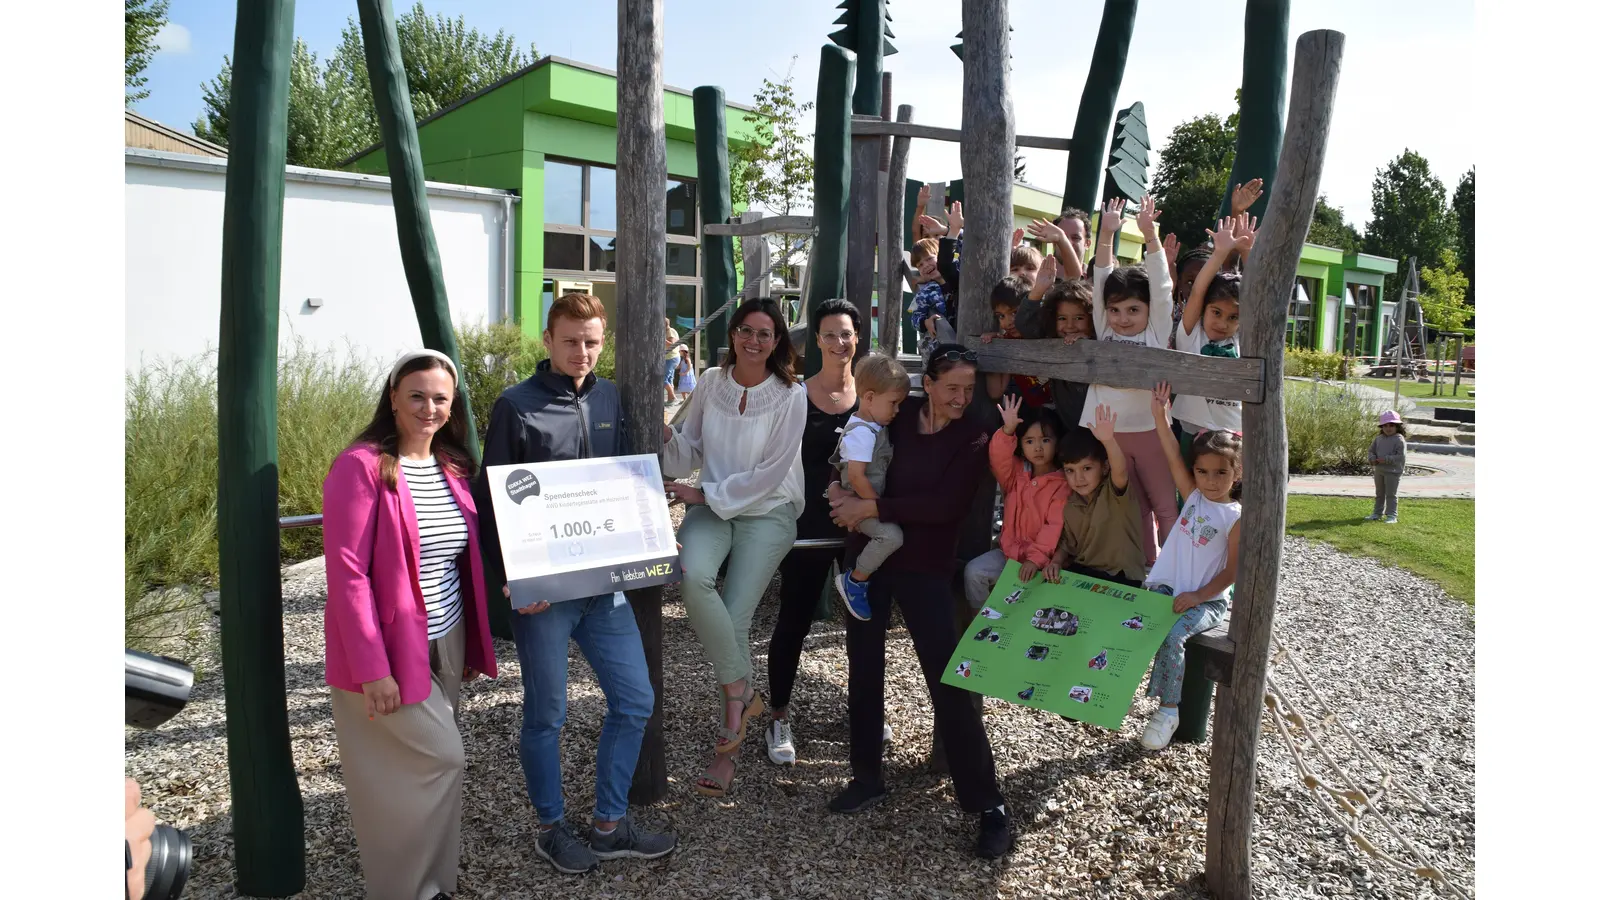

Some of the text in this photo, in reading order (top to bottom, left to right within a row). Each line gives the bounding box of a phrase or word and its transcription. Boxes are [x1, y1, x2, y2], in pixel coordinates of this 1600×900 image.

[508, 474, 533, 490] EDEKA WEZ
[510, 480, 537, 496] Stadthagen
[544, 489, 598, 502] Spendenscheck
[546, 502, 559, 510] AWO
[610, 563, 673, 583] Am liebsten WEZ
